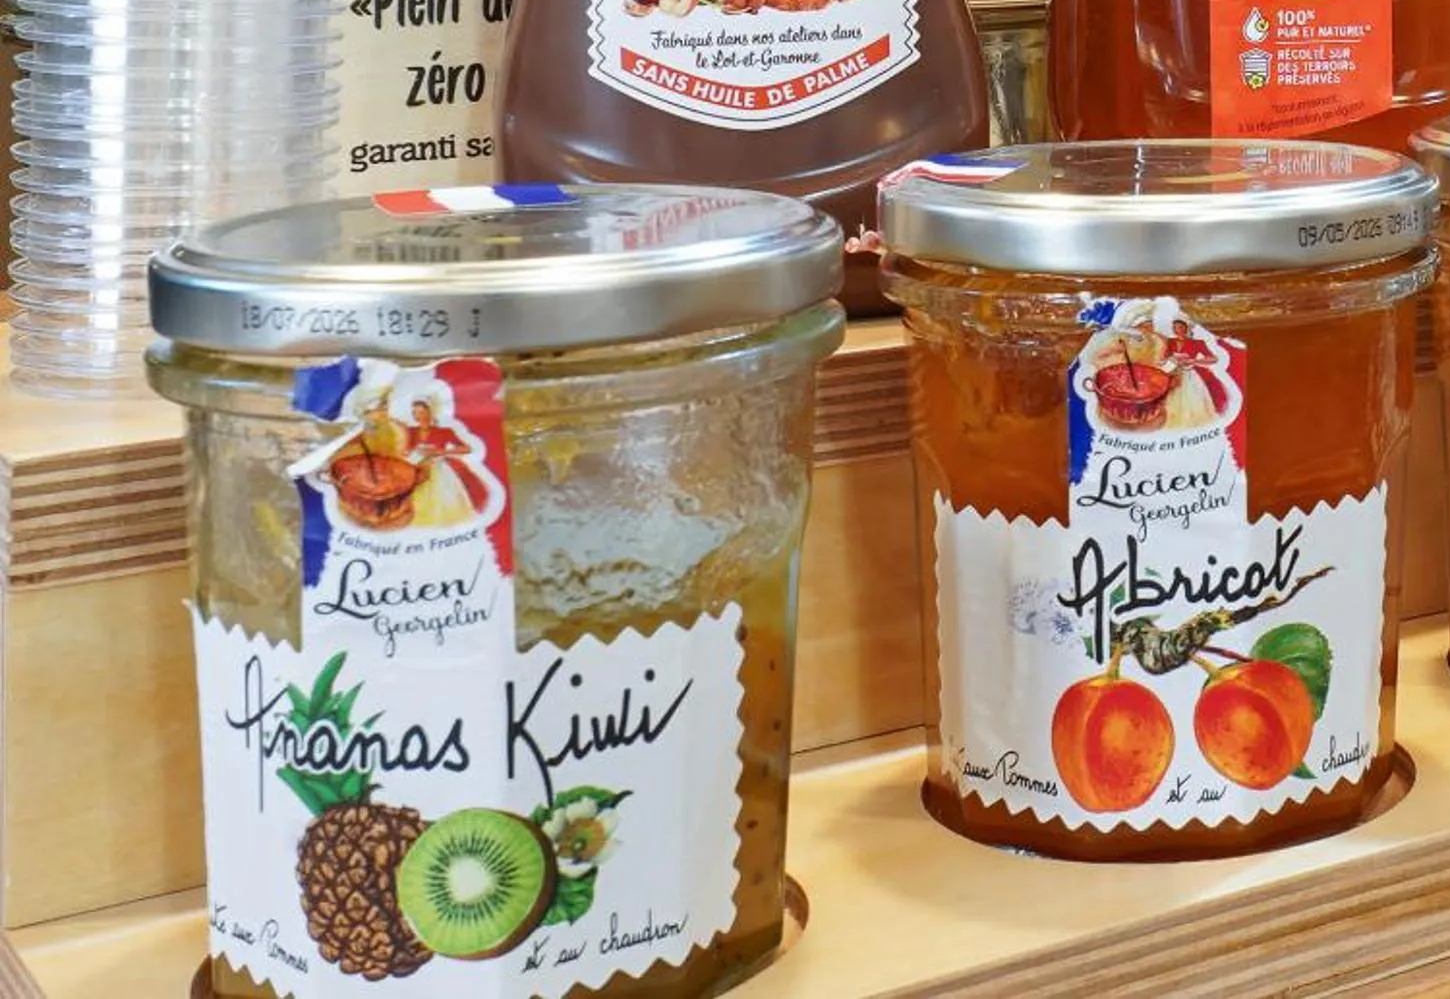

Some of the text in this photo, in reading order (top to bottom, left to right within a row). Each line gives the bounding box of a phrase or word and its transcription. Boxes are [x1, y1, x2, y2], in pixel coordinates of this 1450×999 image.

[650, 24, 863, 50] Fabriqué dans nos ateliers dans
[1276, 9, 1316, 26] 100%
[1276, 27, 1300, 38] PUR
[1302, 26, 1315, 38] ET
[405, 50, 486, 107] zéro
[632, 52, 870, 108] SANS HUILE DE PALME
[695, 49, 822, 71] le Lot-et-Garonne
[1276, 61, 1299, 72] DES
[350, 133, 495, 173] garanti sa
[1098, 427, 1221, 452] Fabriqué en France
[1076, 451, 1226, 509] Lucien
[1128, 481, 1236, 543] Georgelin
[337, 528, 480, 557] Fabriqué en France
[313, 554, 485, 620] Lucien
[1056, 525, 1303, 664] Abricot
[373, 590, 497, 659] Georgelin
[224, 655, 694, 812] Ananas Kiwi
[963, 761, 995, 780] aux
[994, 750, 1059, 797] Pommes
[1165, 774, 1192, 803] et
[1196, 784, 1228, 803] au
[520, 935, 550, 974] et
[552, 940, 587, 967] au
[599, 907, 689, 955] chaudron
